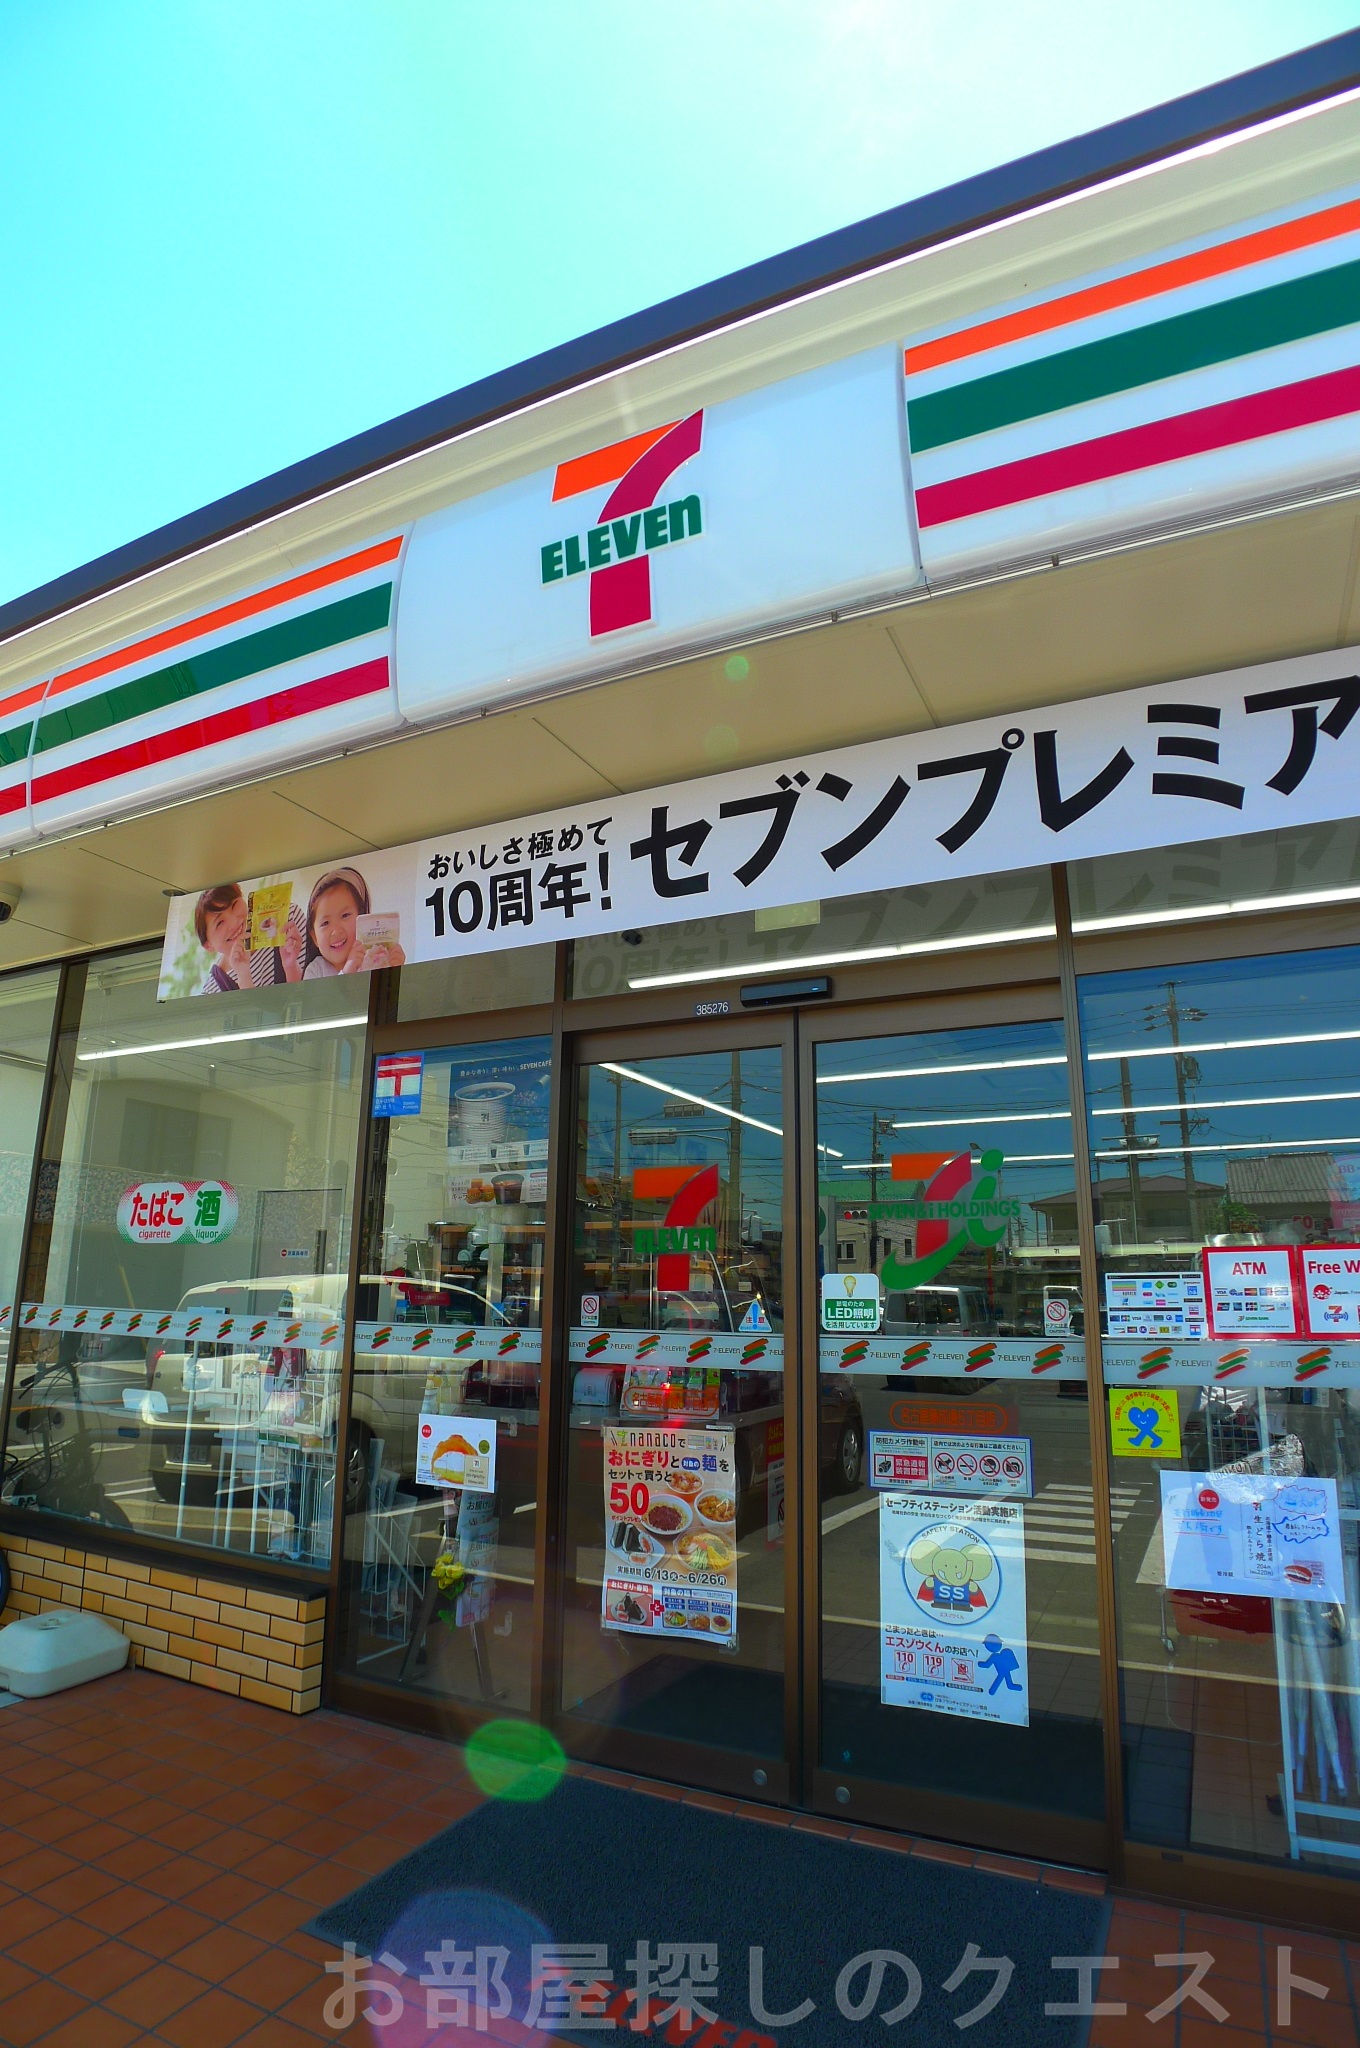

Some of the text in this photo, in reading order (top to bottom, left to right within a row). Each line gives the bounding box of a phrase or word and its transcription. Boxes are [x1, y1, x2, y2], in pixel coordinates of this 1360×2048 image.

[629, 674, 1360, 899] セブンプレミア
[427, 816, 613, 880] おいしさ極めて
[425, 851, 612, 937] 10周年!
[695, 1001, 730, 1016] 385276
[129, 1190, 223, 1228] たばこ 酒
[937, 1199, 1022, 1219] HOLDINGS
[138, 1229, 220, 1240] cigarette liquor
[1231, 1261, 1268, 1276] ATM
[1307, 1260, 1341, 1275] Free
[826, 1306, 875, 1320] LED照明
[825, 1320, 877, 1330] を活用しています
[875, 1437, 926, 1447] 防犯カメラ作動中
[607, 1468, 673, 1483] セットで買うと
[609, 1482, 650, 1517] 50
[885, 1497, 1019, 1519] セーフティステーション活動実施店
[921, 1525, 981, 1544] SAFETY STATION
[1253, 1514, 1267, 1562] 生どら焼
[885, 1636, 980, 1658] エスゾウくんのお店へ!
[896, 1651, 943, 1667] 110 119
